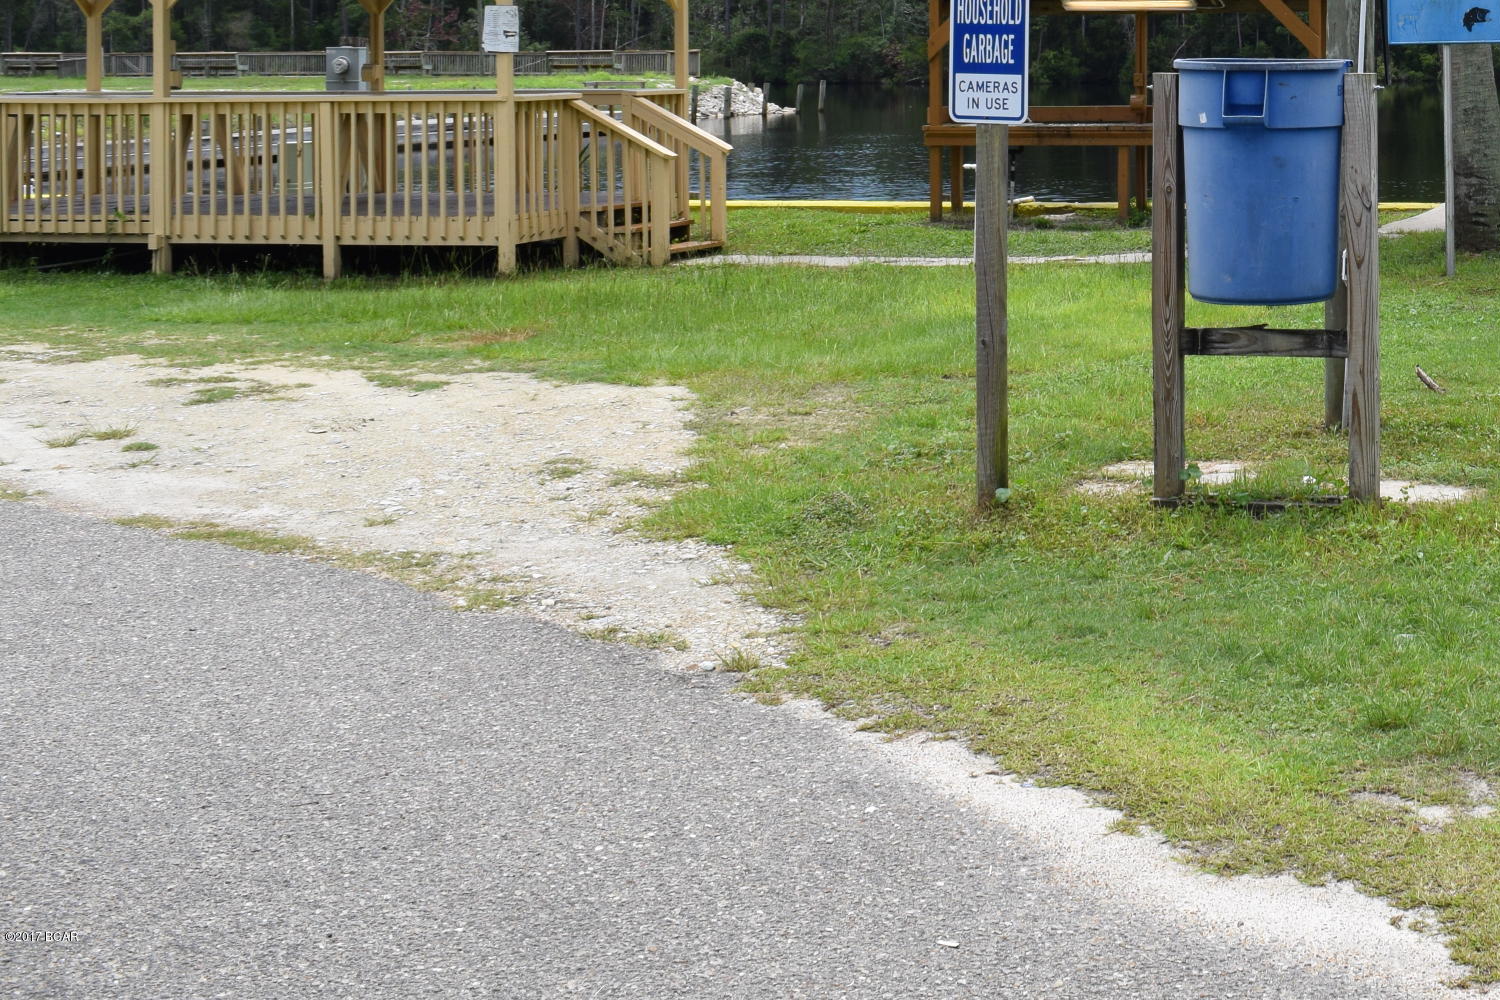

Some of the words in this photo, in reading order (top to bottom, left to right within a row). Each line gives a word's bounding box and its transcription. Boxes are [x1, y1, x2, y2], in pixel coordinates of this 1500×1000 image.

[963, 33, 1015, 65] GARBAGE
[958, 80, 1018, 94] CAMERAS
[967, 97, 980, 110] IN
[985, 97, 1009, 110] USE
